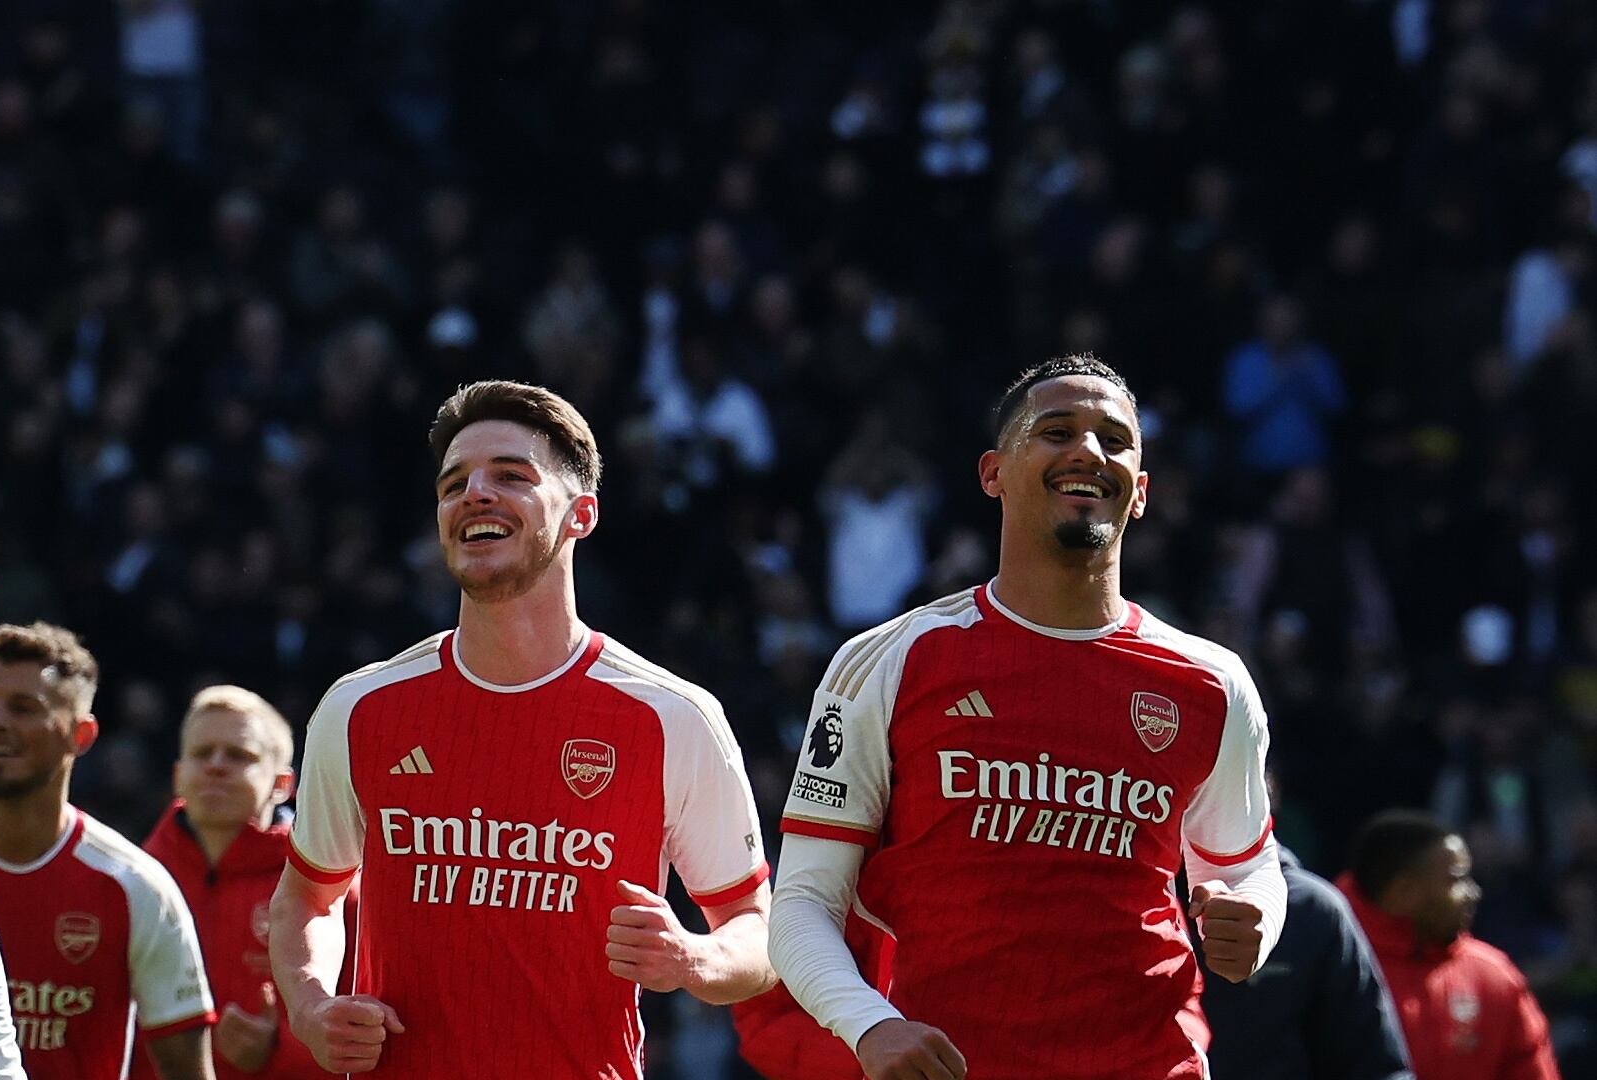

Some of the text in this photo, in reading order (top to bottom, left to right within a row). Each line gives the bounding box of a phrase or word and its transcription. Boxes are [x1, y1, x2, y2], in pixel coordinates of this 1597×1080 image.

[570, 748, 608, 762] Arsenal
[804, 788, 845, 809] racism
[807, 777, 841, 796] room
[936, 750, 1174, 824] Emirates
[379, 806, 616, 870] Emirates
[970, 803, 1138, 859] FLY BETTER
[412, 864, 579, 913] FLY BETTER
